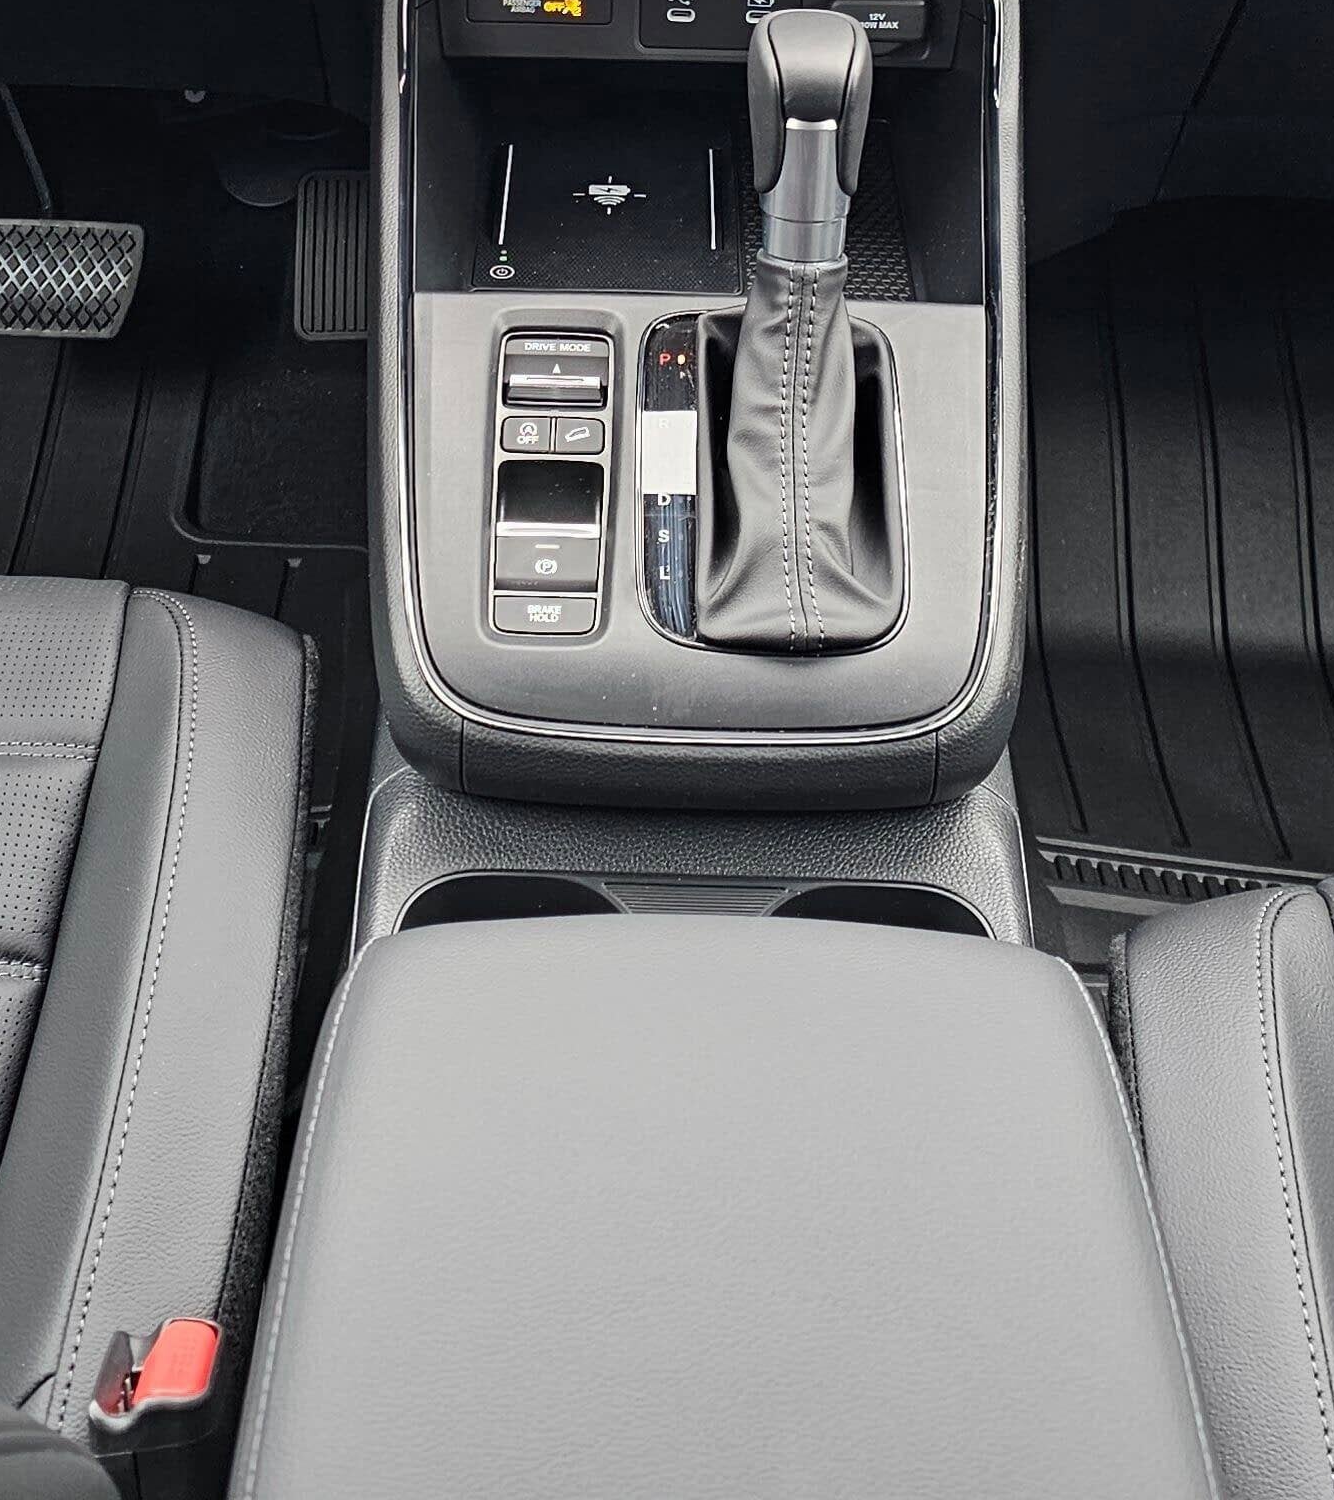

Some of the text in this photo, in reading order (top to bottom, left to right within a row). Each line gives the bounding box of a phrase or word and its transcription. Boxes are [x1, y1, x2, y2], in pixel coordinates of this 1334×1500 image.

[879, 21, 899, 29] MAX
[524, 342, 591, 352] DRIVE MODE
[660, 353, 671, 365] P
[516, 436, 540, 444] OFF
[658, 494, 671, 506] D
[658, 530, 669, 542] S
[527, 605, 562, 614] BRAKE
[529, 614, 559, 622] HOLD
